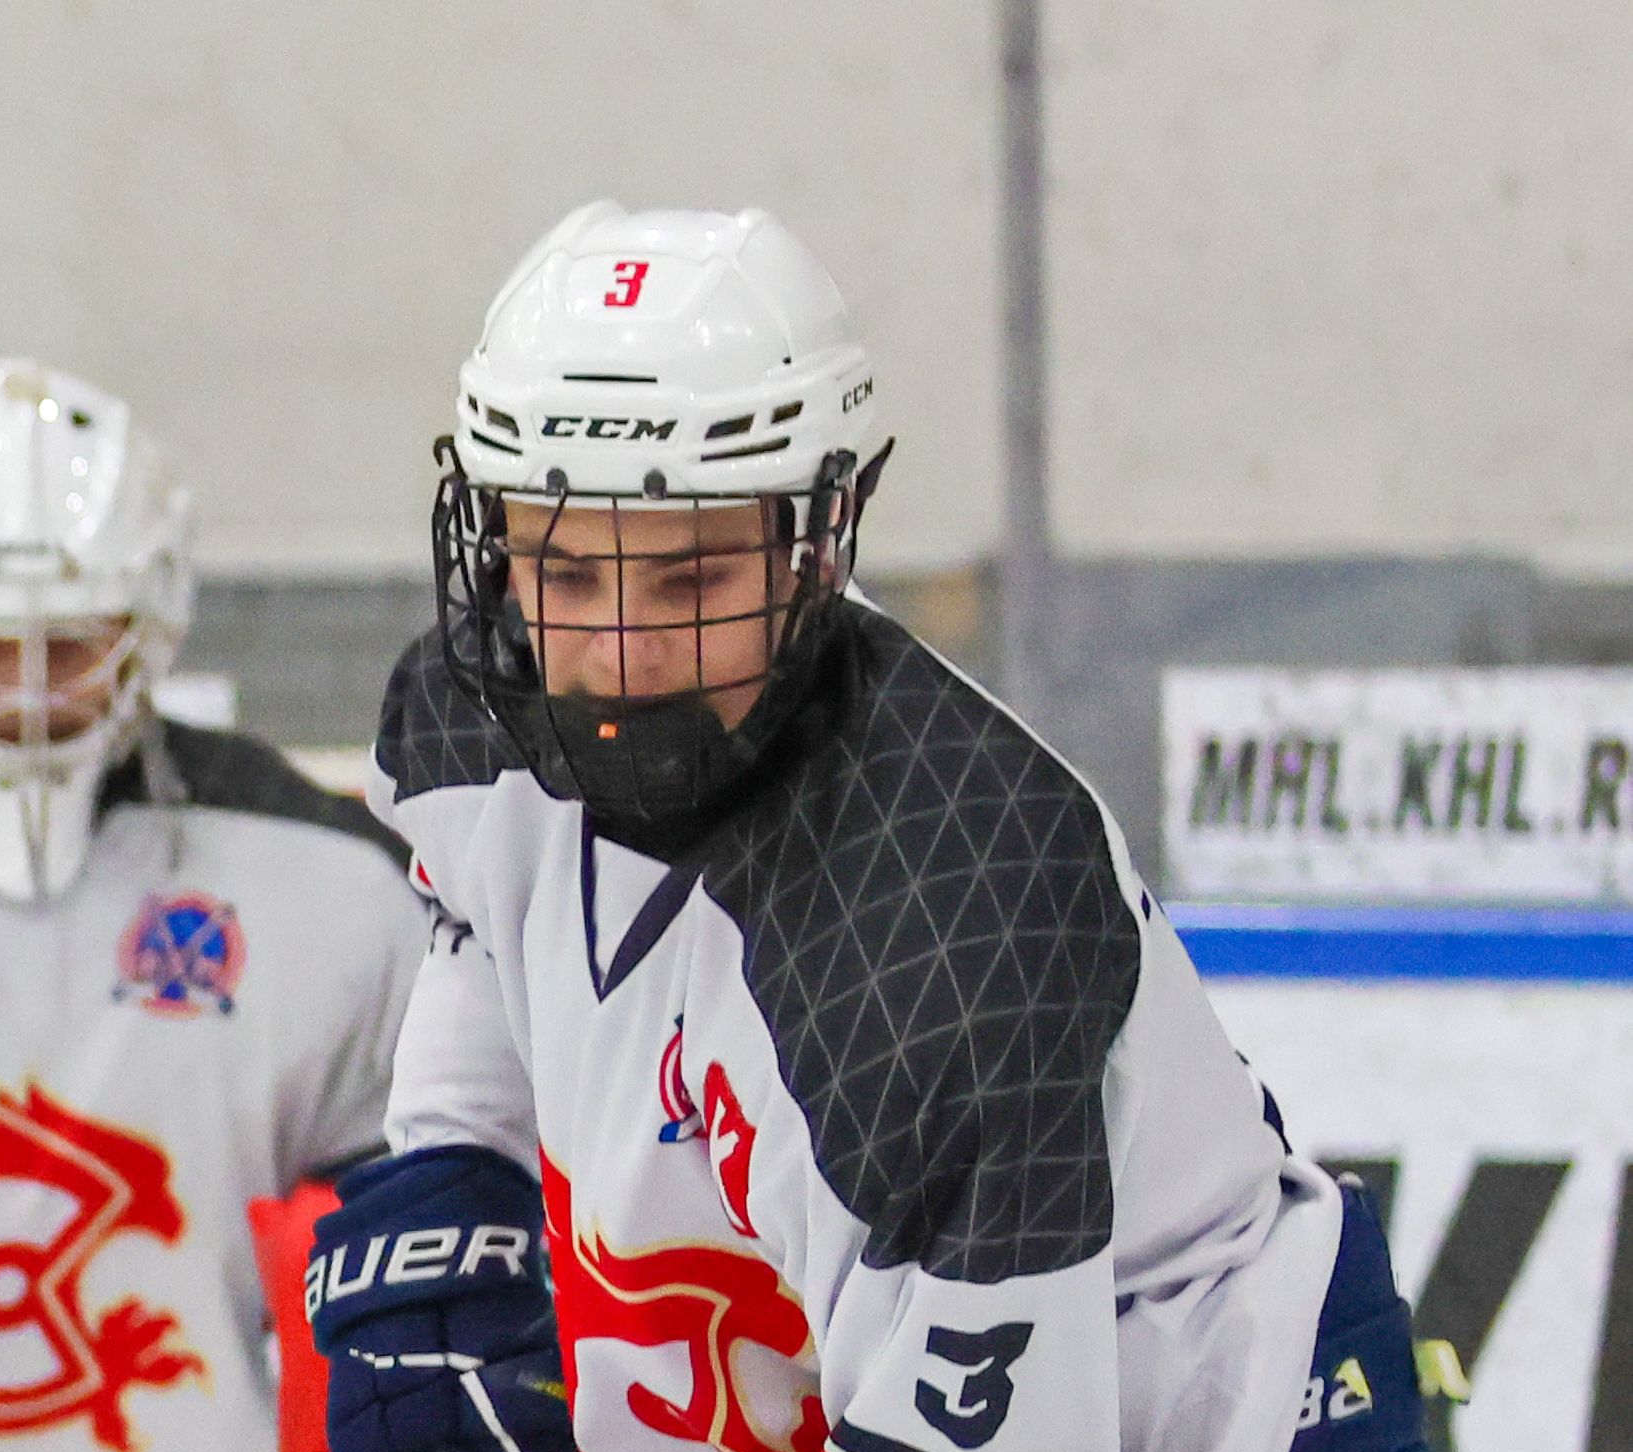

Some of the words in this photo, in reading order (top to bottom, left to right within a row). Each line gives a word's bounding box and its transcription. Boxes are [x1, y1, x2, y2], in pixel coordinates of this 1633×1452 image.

[604, 261, 649, 307] 3
[540, 415, 677, 441] CCM
[842, 377, 873, 414] CCM
[1188, 734, 1632, 832] MHL.KHL.R
[304, 1224, 530, 1324] AUER
[913, 1323, 1034, 1448] 3
